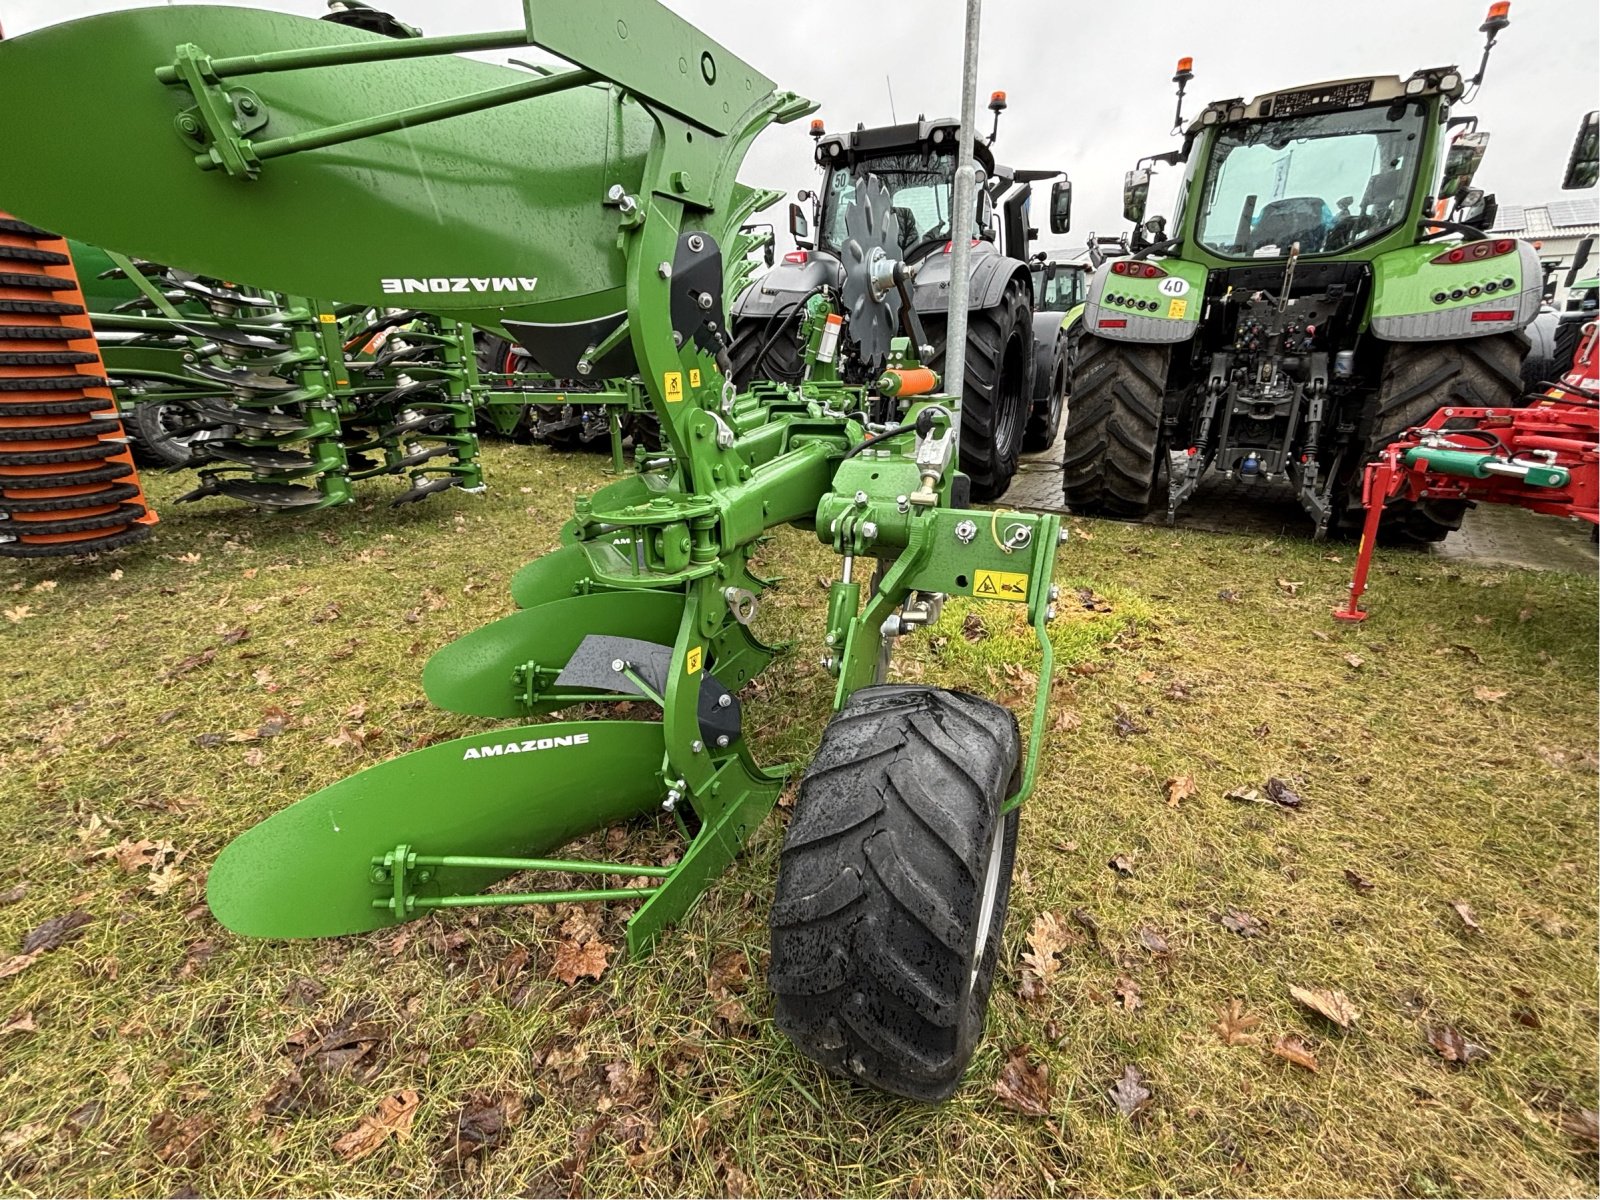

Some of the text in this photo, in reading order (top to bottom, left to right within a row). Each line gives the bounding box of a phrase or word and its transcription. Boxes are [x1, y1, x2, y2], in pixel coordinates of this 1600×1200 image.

[835, 173, 846, 188] 50
[381, 277, 537, 294] AMAZONE
[1164, 280, 1183, 293] 40
[463, 733, 589, 760] AMAZONE
